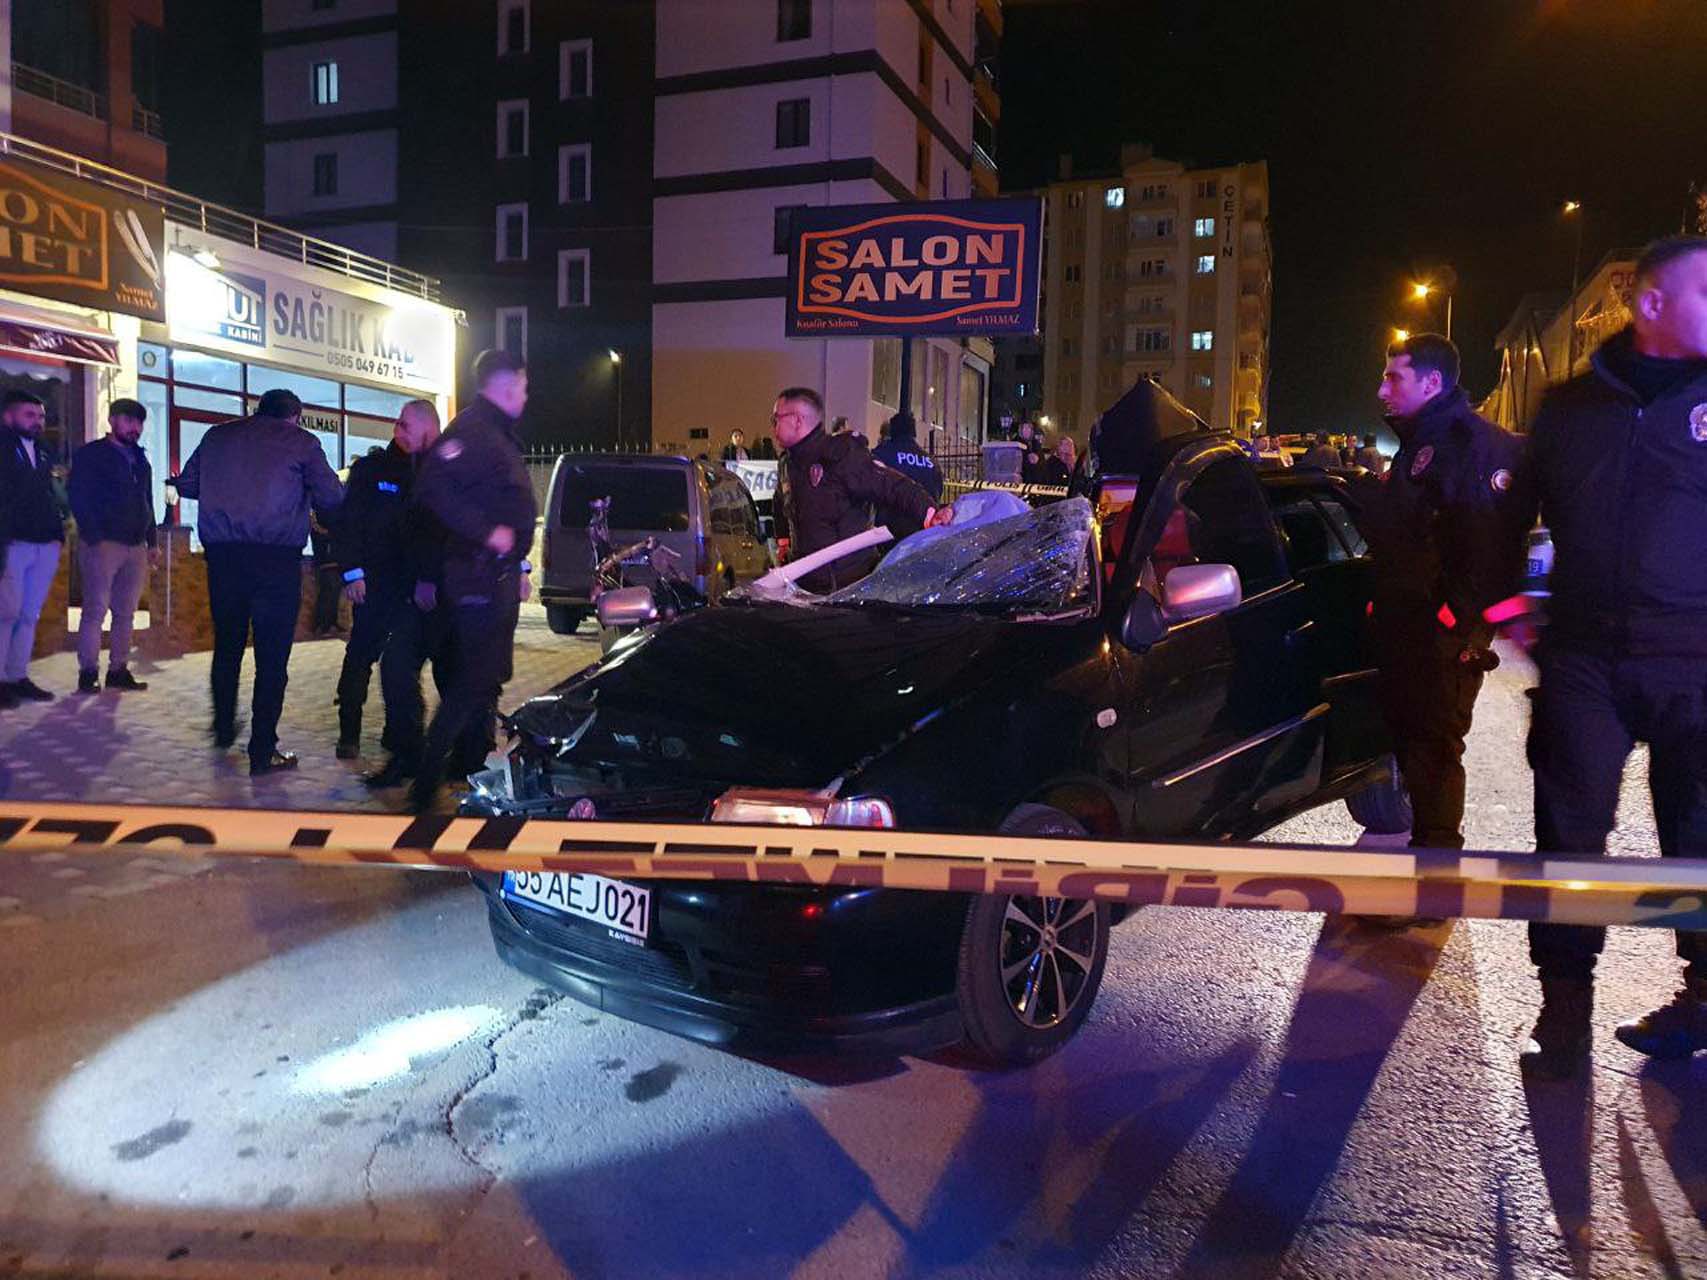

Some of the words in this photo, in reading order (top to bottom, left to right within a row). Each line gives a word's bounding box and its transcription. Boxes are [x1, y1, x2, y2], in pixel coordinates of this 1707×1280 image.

[0, 226, 92, 274] ET
[815, 234, 1004, 270] SALON
[809, 268, 1011, 304] SAMET
[273, 288, 365, 354] SAĞLIK
[327, 351, 353, 370] 0505
[355, 356, 375, 375] 049
[377, 362, 390, 376] 67
[393, 365, 404, 380] 15
